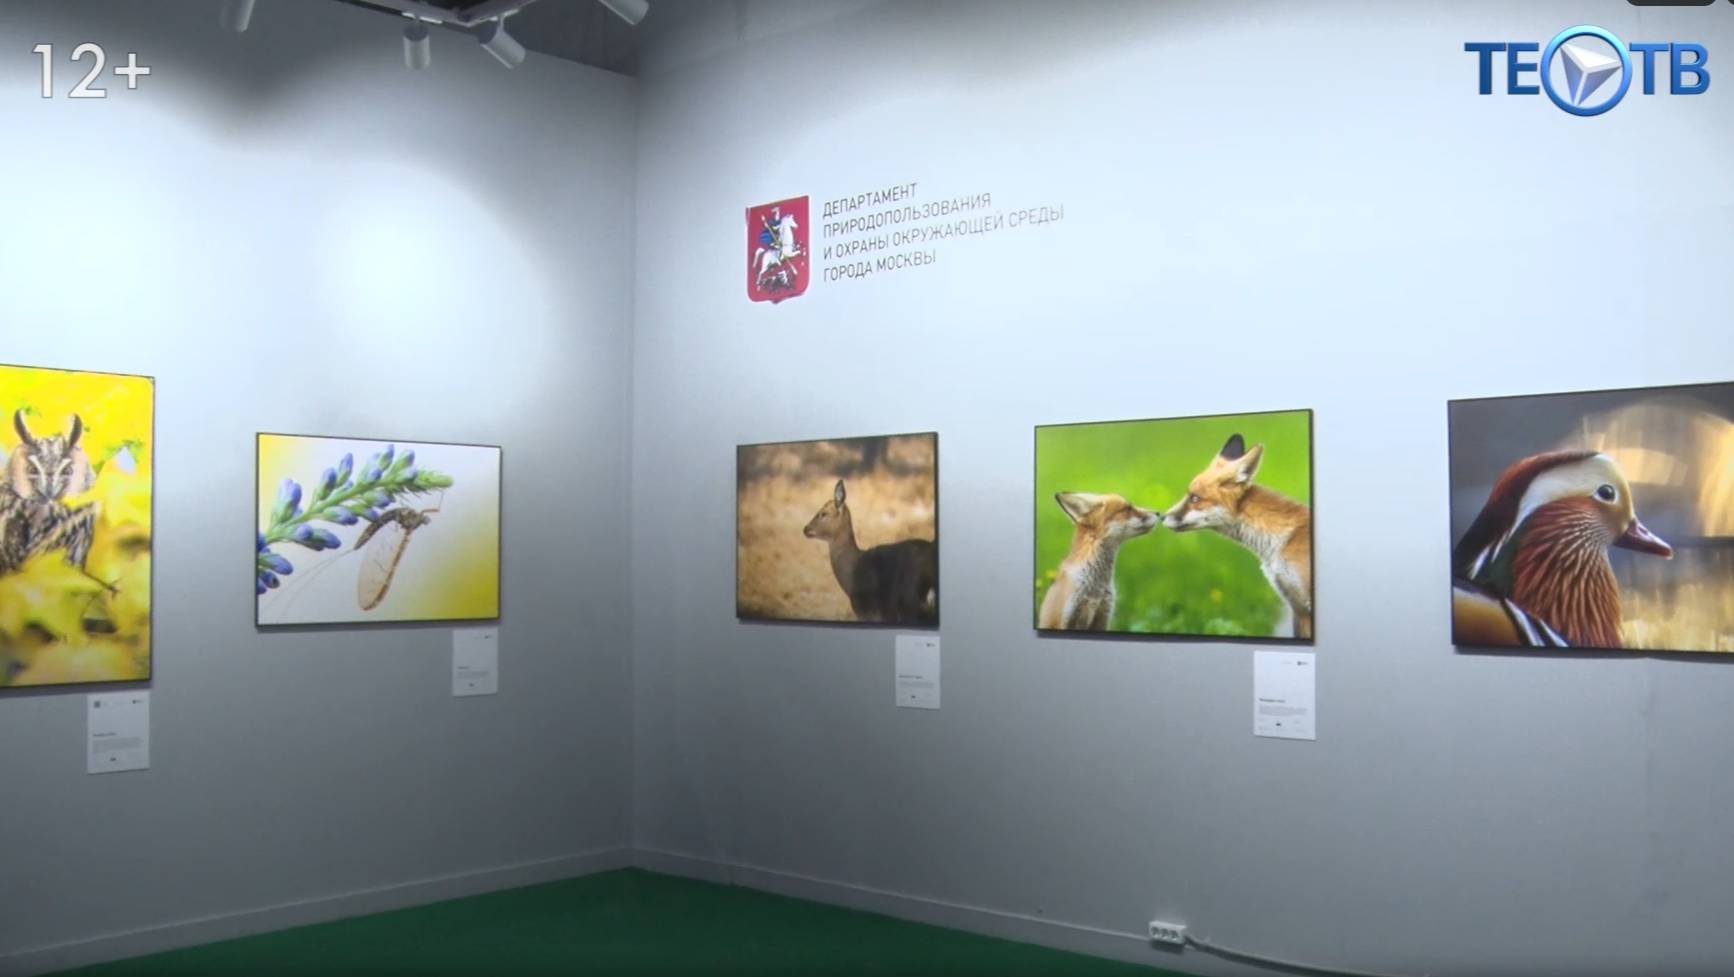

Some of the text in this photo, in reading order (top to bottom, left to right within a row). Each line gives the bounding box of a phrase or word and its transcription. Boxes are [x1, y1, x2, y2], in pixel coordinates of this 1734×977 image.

[822, 183, 918, 220] ДЕПАРТАМЕНТ
[823, 192, 992, 238] ПРИРОДОПОЛЬЗОВАНИЯ
[823, 204, 1065, 260] И ОХРАНЫ ОКРУЖАЮЩЕЙ СРЕДЫ
[823, 248, 936, 282] ГОРОДА МОСКВЫ
